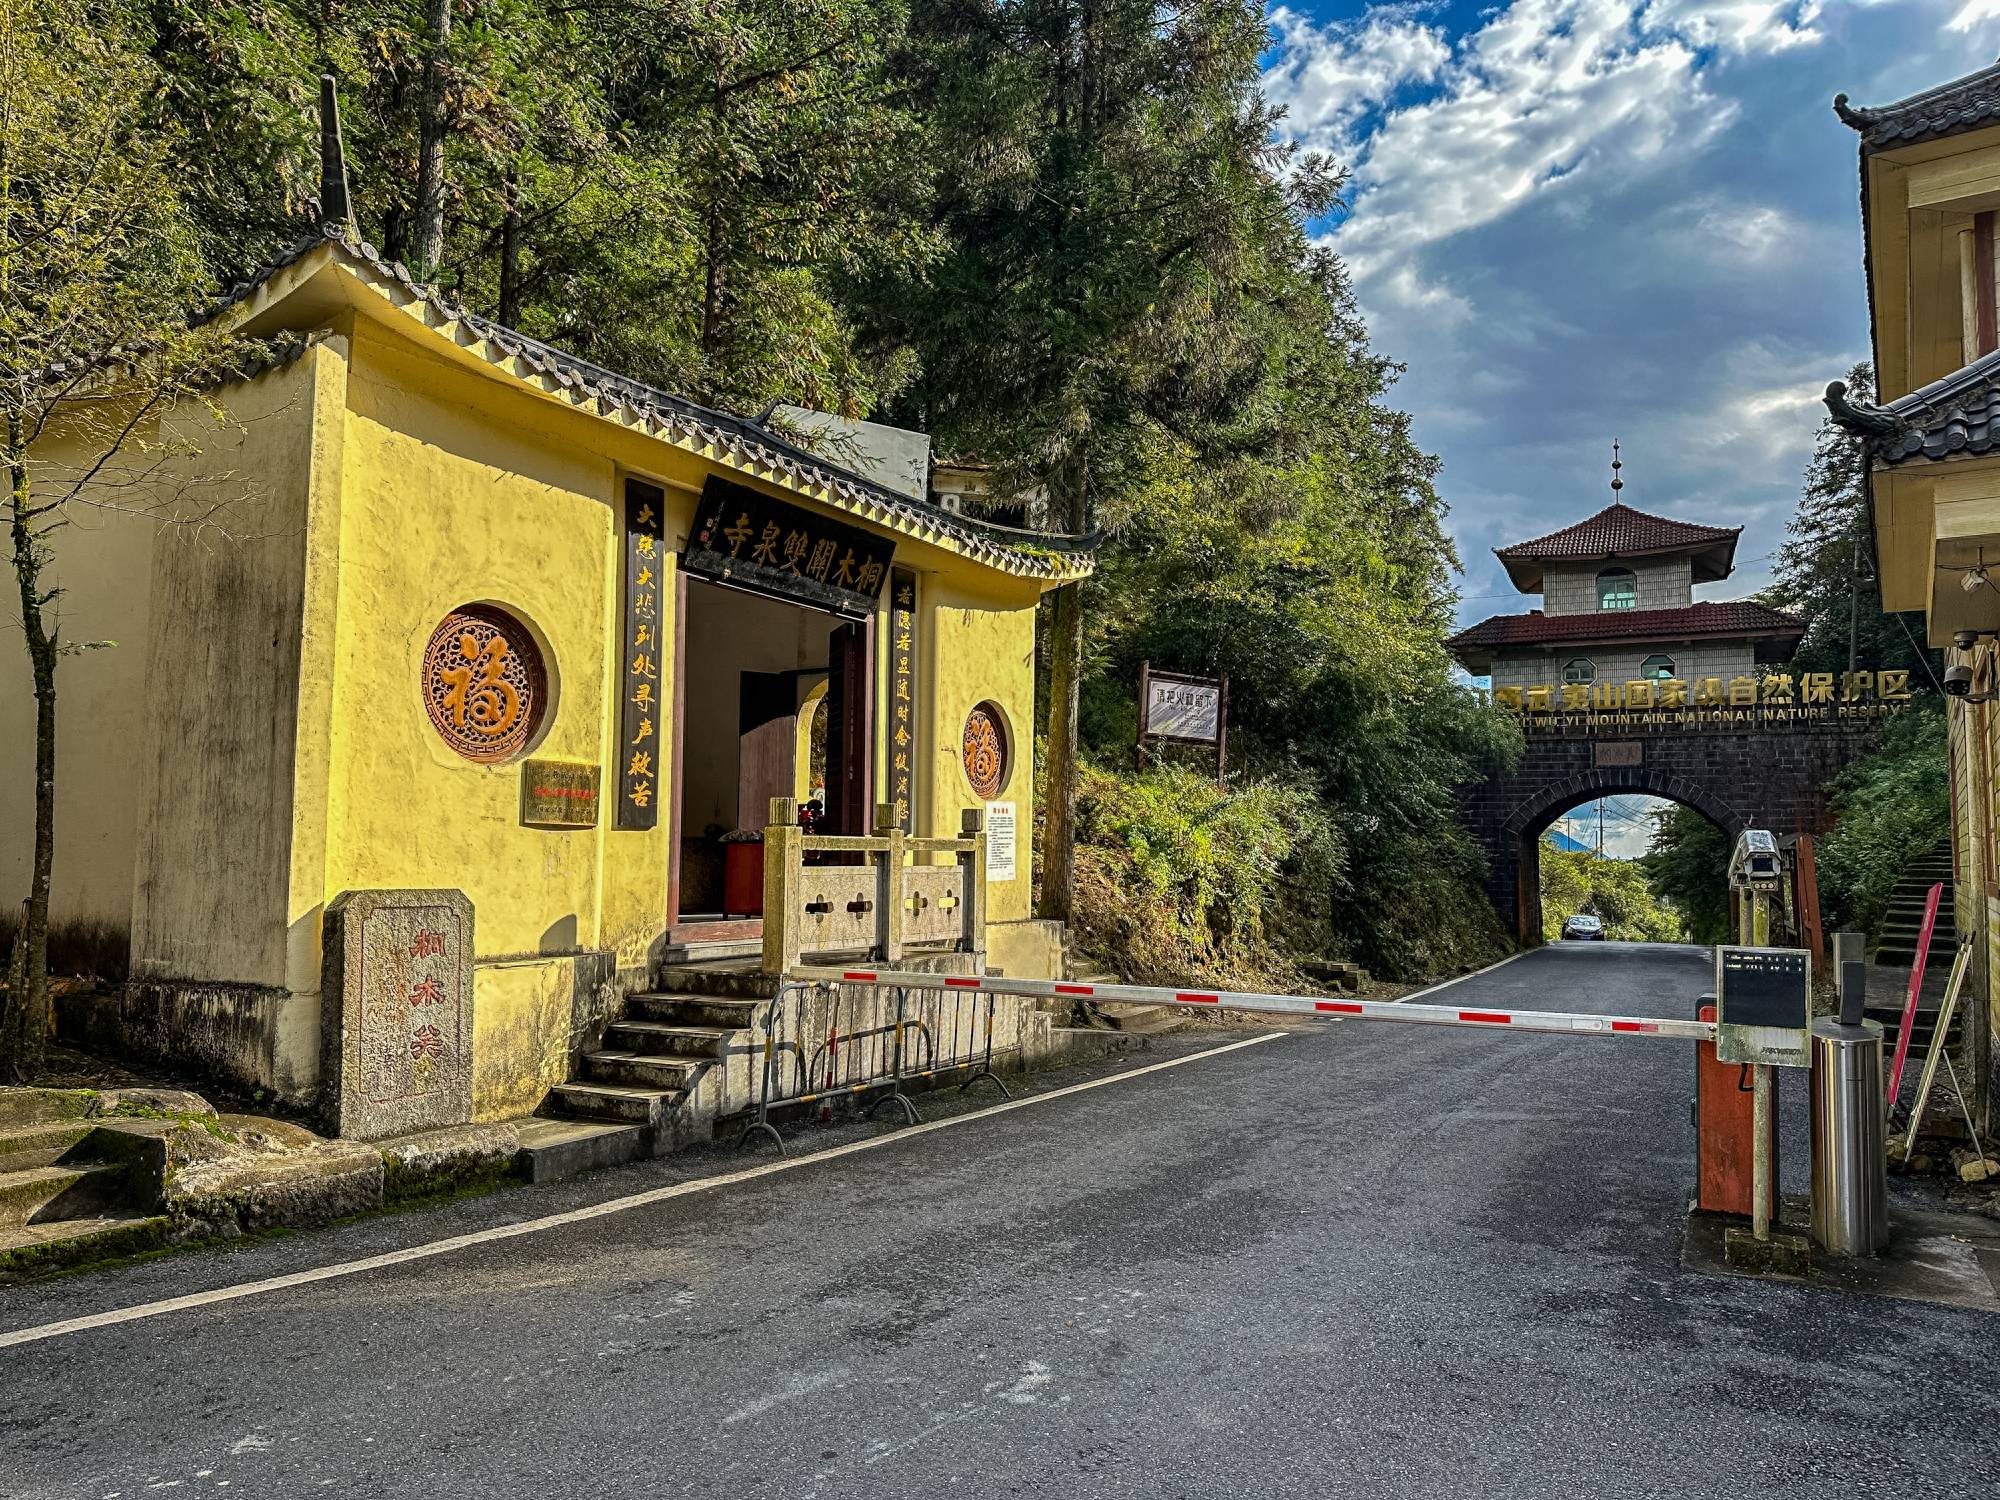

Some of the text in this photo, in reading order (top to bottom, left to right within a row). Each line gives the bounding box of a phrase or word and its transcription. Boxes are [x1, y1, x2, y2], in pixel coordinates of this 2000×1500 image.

[440, 633, 520, 736] 福
[1534, 716, 1558, 728] WU
[1565, 715, 1580, 727] YI
[1587, 712, 1667, 727] MOUNTAIN
[1675, 709, 1755, 724] NATIONAL
[1763, 707, 1829, 721] NATURE
[964, 718, 997, 782] 福
